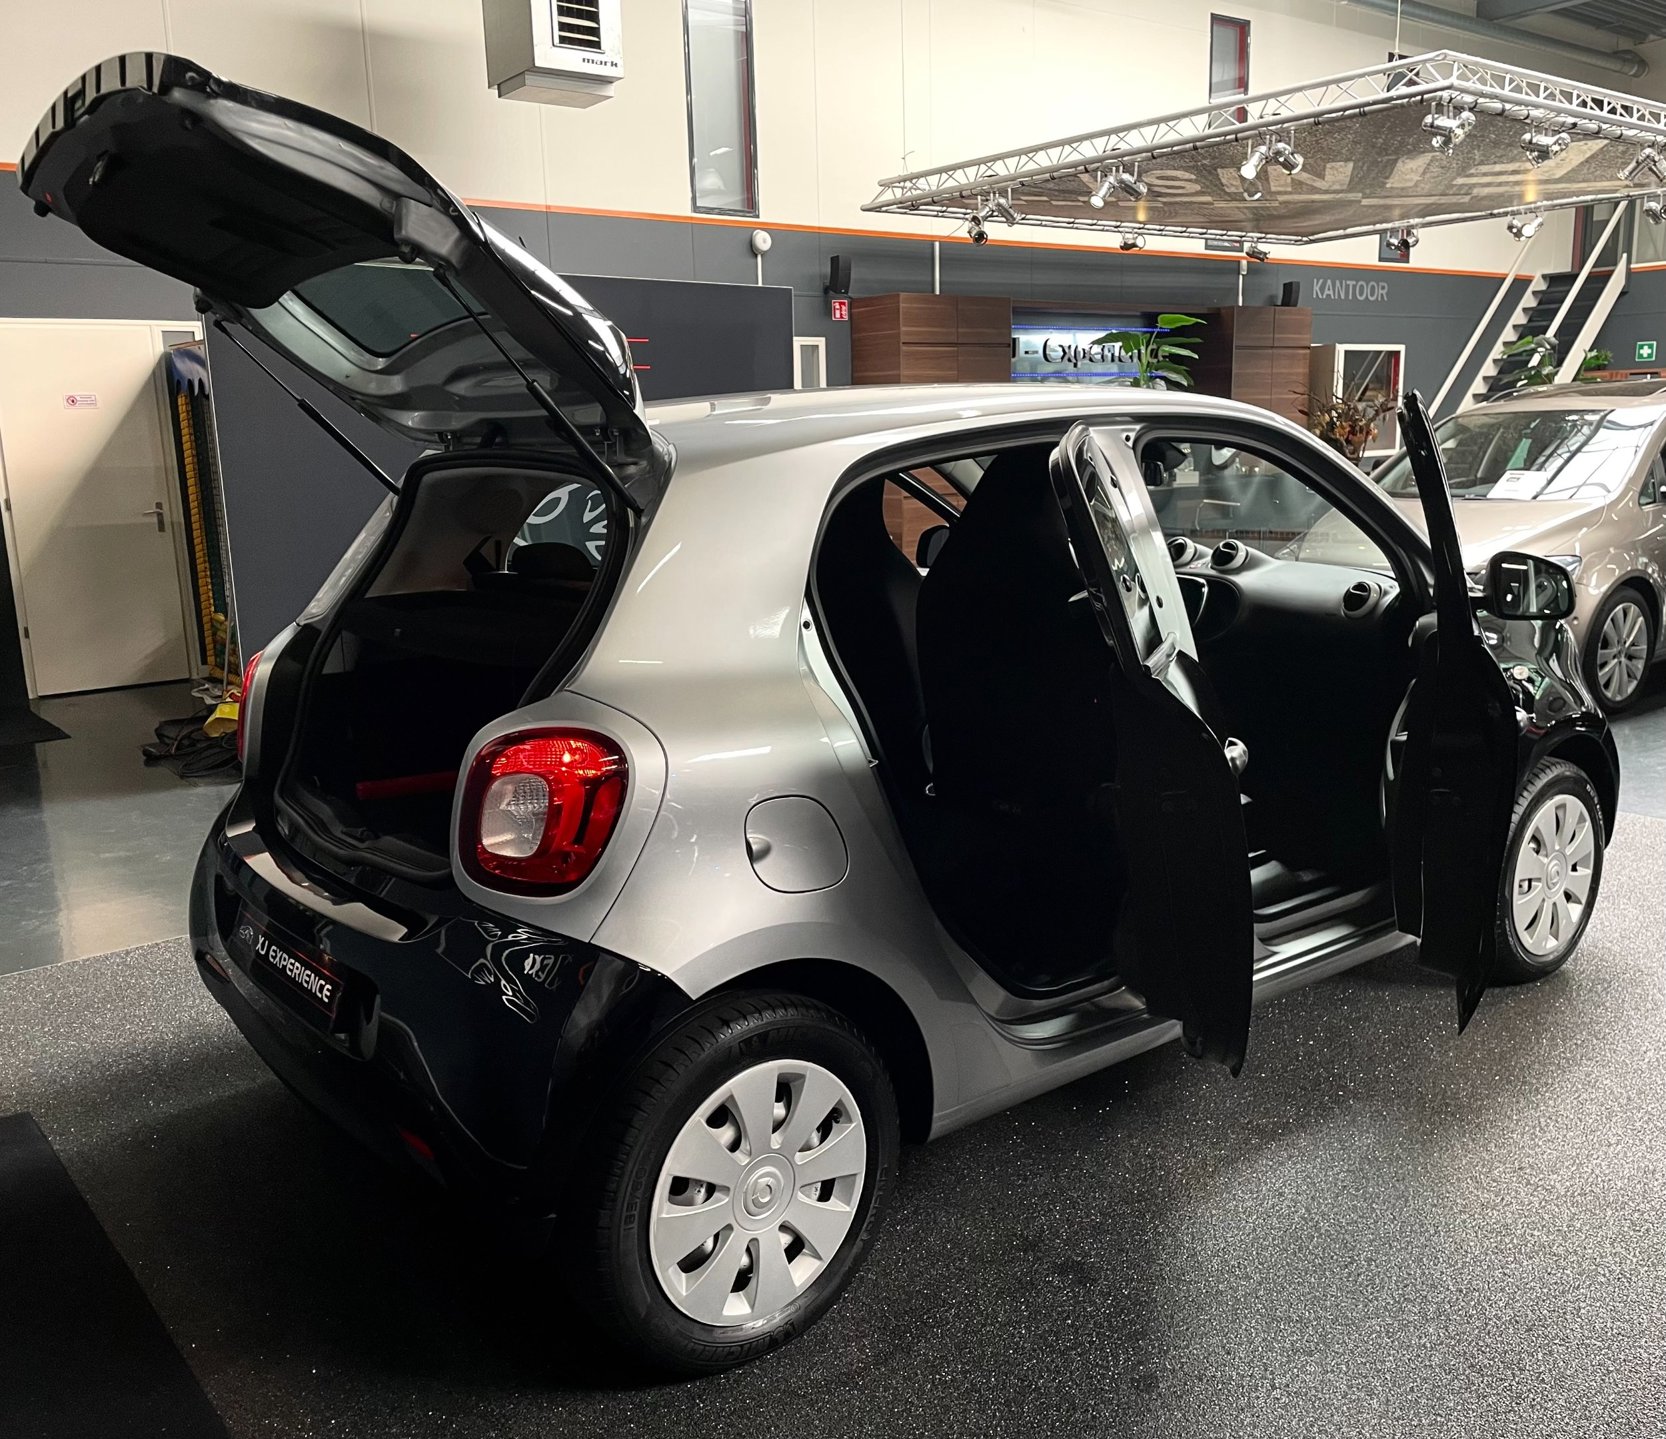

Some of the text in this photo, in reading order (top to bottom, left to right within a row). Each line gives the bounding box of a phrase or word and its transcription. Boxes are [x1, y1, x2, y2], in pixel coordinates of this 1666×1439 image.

[582, 57, 618, 68] mark
[1312, 277, 1388, 301] KANTOOR
[268, 945, 333, 1003] EXPERIENCE
